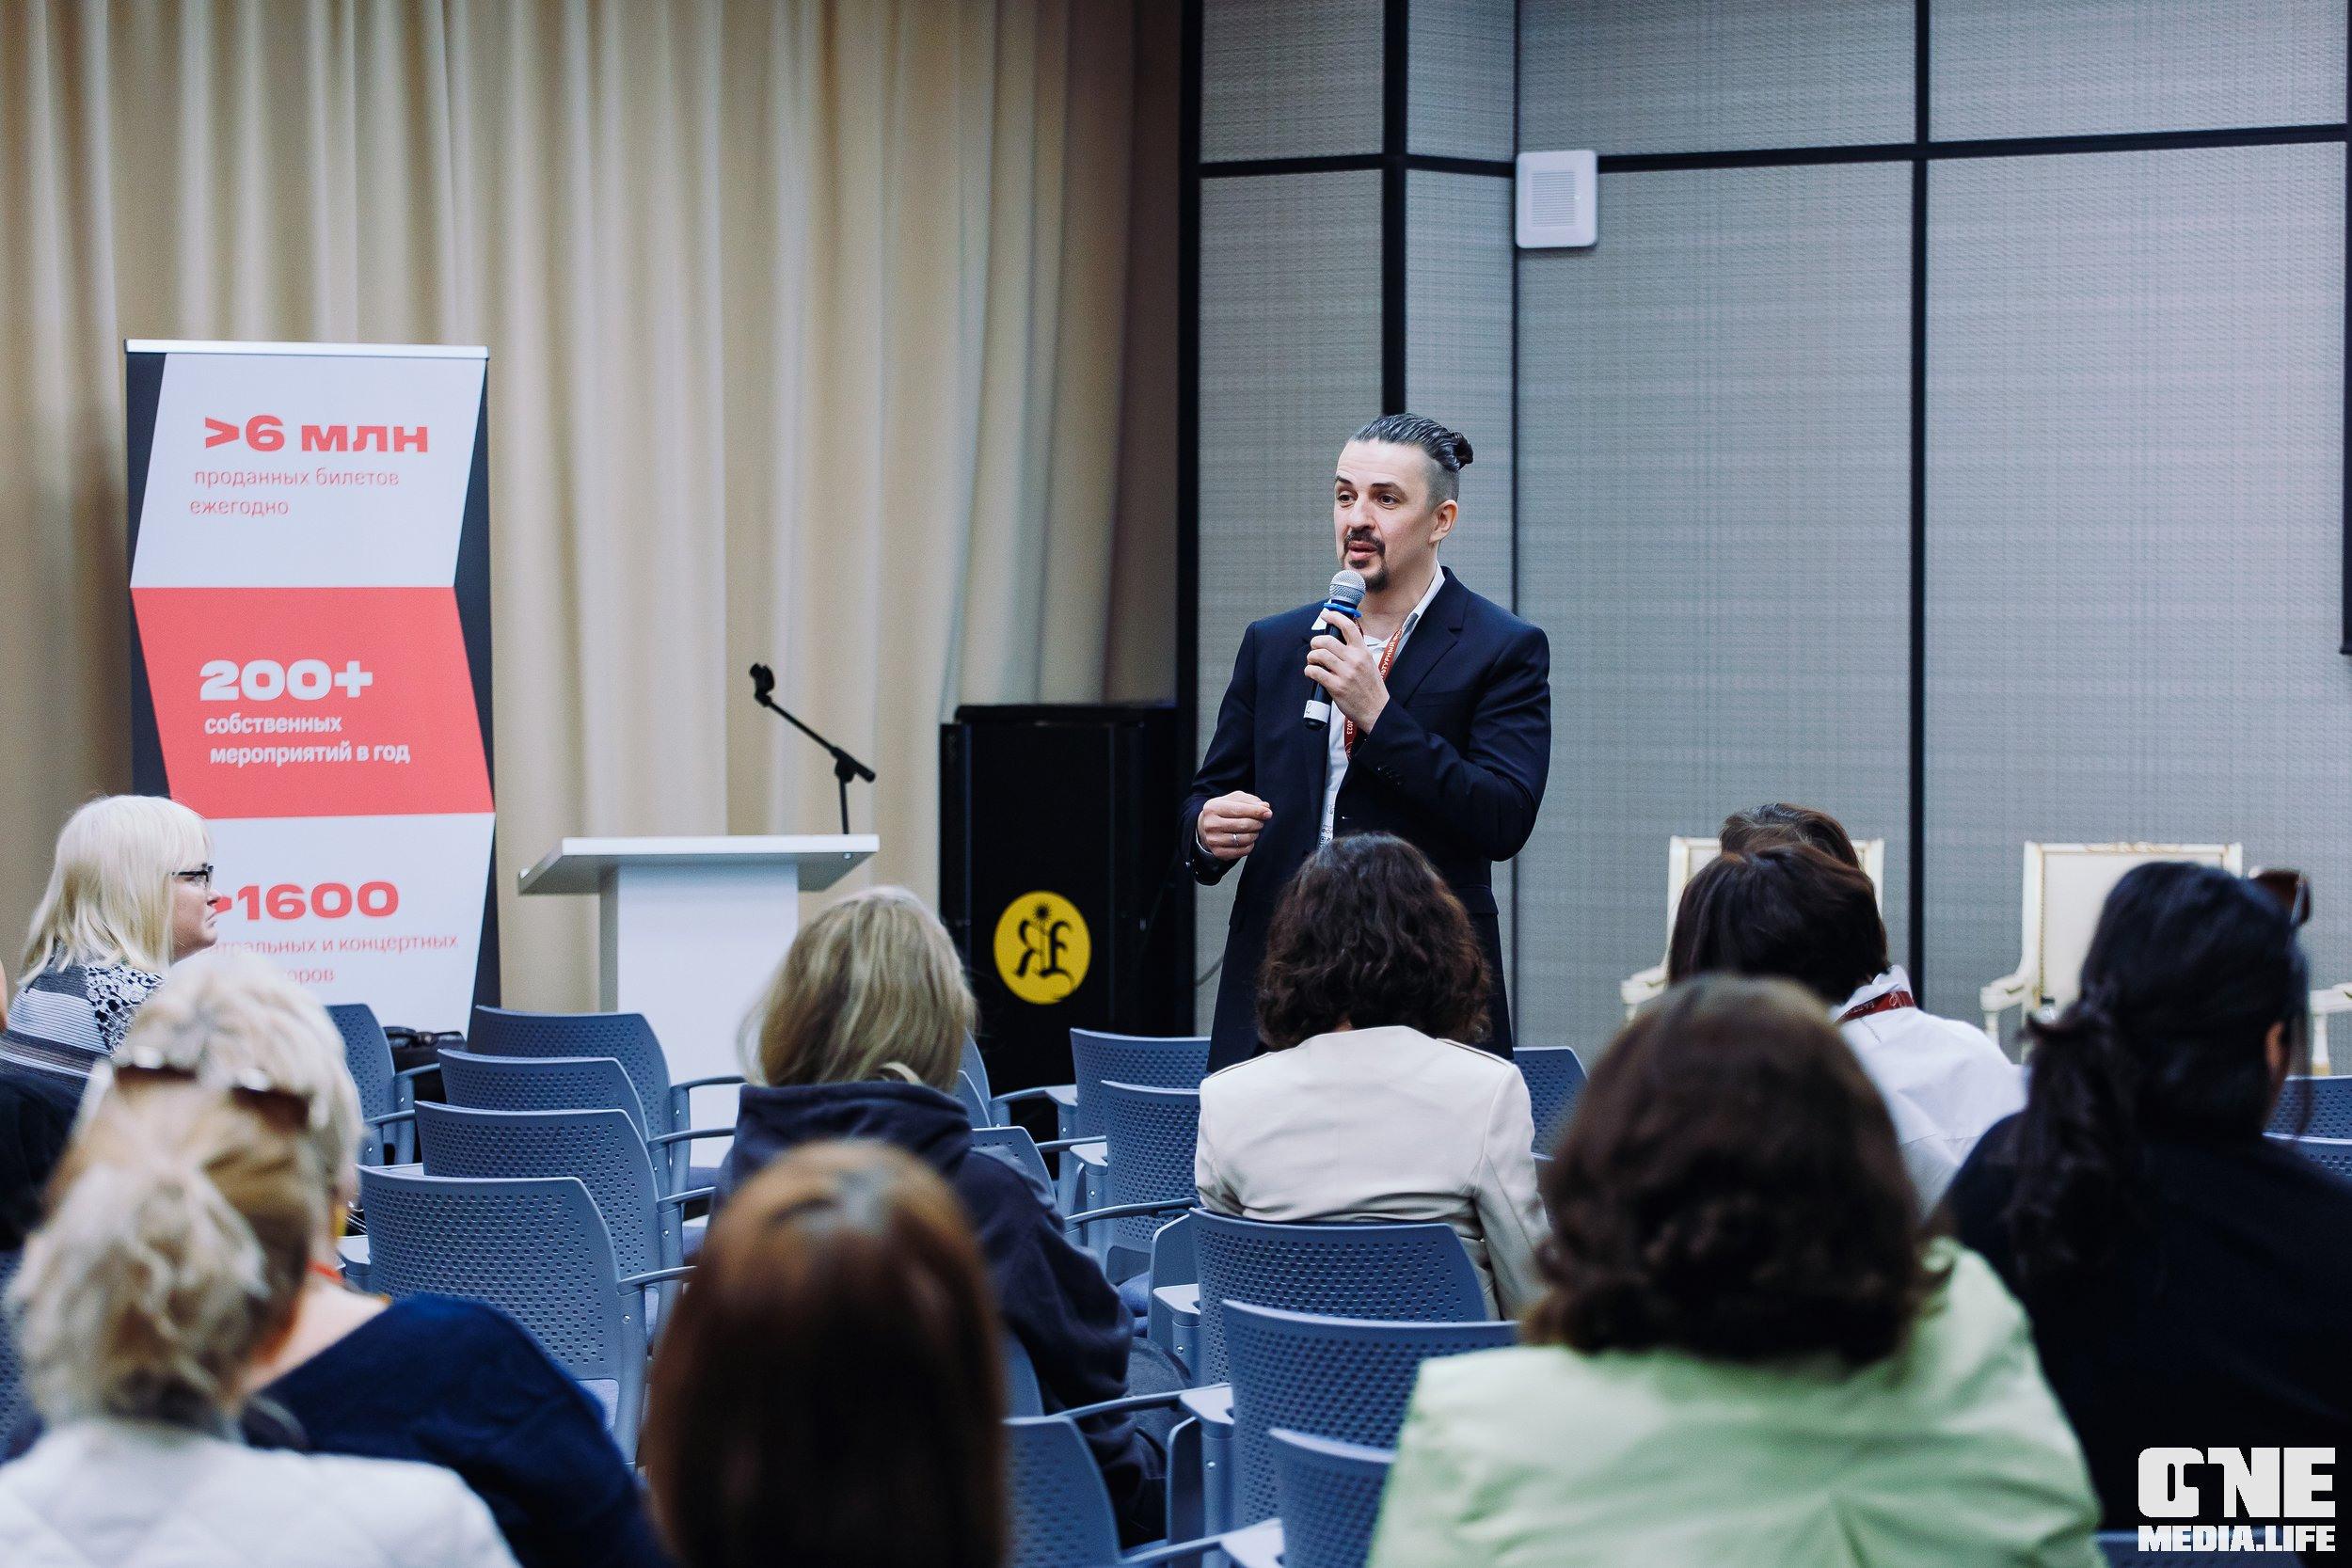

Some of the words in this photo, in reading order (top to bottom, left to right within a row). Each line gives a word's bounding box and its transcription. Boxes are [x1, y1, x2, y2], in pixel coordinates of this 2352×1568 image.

[205, 414, 285, 452] >6
[301, 425, 429, 452] млн
[195, 468, 309, 488] проданных
[316, 467, 399, 486] билетов
[190, 499, 289, 517] ежегодно
[1379, 641, 1397, 678] ЛЬТУРНЫЙ
[199, 659, 373, 701] 200+
[205, 712, 342, 735] собственных
[210, 740, 352, 768] мероприятий
[357, 745, 369, 763] в
[373, 744, 410, 765] год
[322, 939, 334, 952] и
[339, 935, 459, 954] концертных
